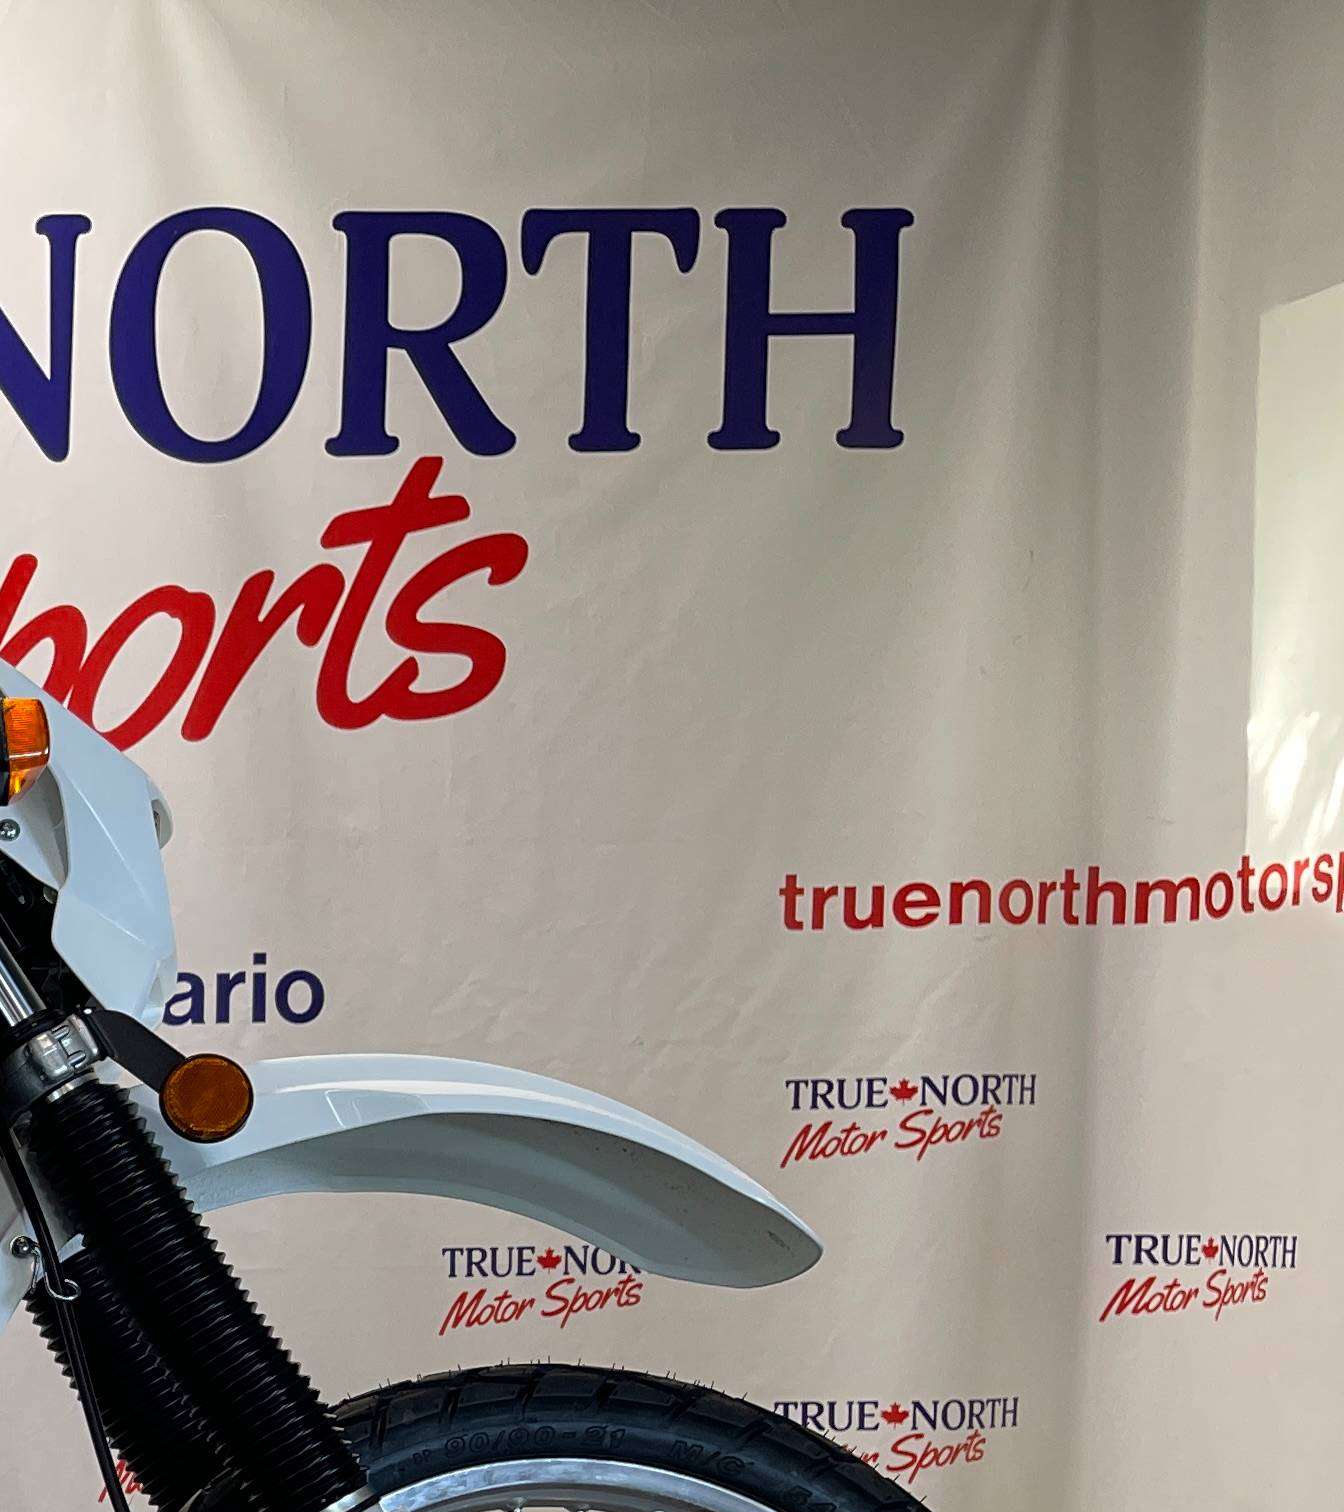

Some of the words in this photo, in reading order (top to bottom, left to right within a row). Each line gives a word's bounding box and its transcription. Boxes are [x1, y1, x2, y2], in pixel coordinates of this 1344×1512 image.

[778, 851, 1344, 932] truenorthmotors
[162, 953, 325, 1025] ario
[785, 1077, 888, 1110] TRUE
[919, 1074, 1037, 1107] NORTH
[780, 1120, 887, 1168] Motor
[894, 1105, 1002, 1160] Sports
[441, 1246, 537, 1278] TRUE
[1105, 1234, 1202, 1267] TRUE
[1219, 1235, 1298, 1268] NORTH
[439, 1288, 536, 1336] Motor
[540, 1274, 644, 1328] Sports
[1099, 1275, 1199, 1322] Motor
[1202, 1267, 1268, 1320] Sports
[444, 1425, 627, 1451] 90/90-21
[774, 1400, 880, 1431] TRUE
[911, 1397, 1019, 1431] NORTH
[886, 1429, 987, 1484] Sports
